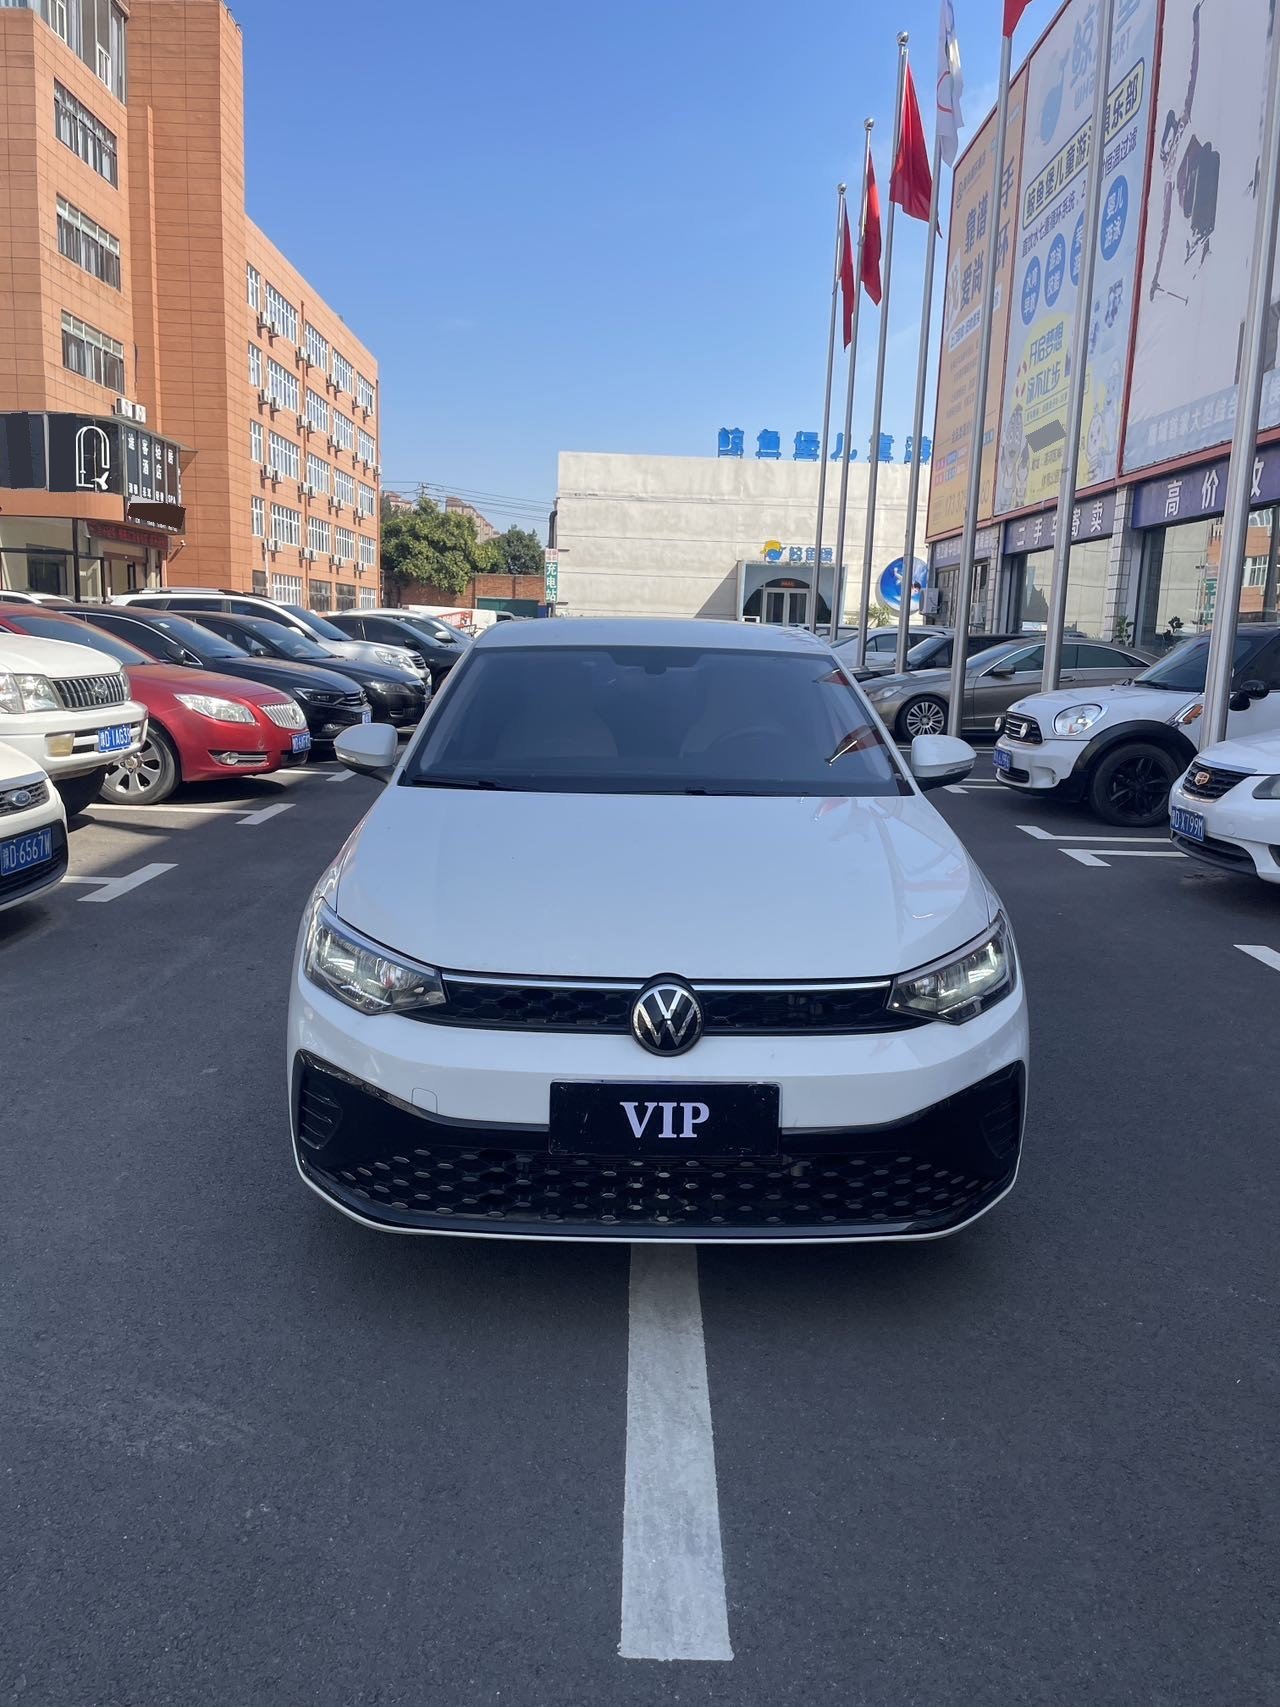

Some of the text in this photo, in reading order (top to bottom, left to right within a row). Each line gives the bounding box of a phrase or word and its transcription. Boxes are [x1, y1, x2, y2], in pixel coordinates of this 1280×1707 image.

[546, 563, 557, 602] 充电站
[620, 1101, 710, 1139] VIP
